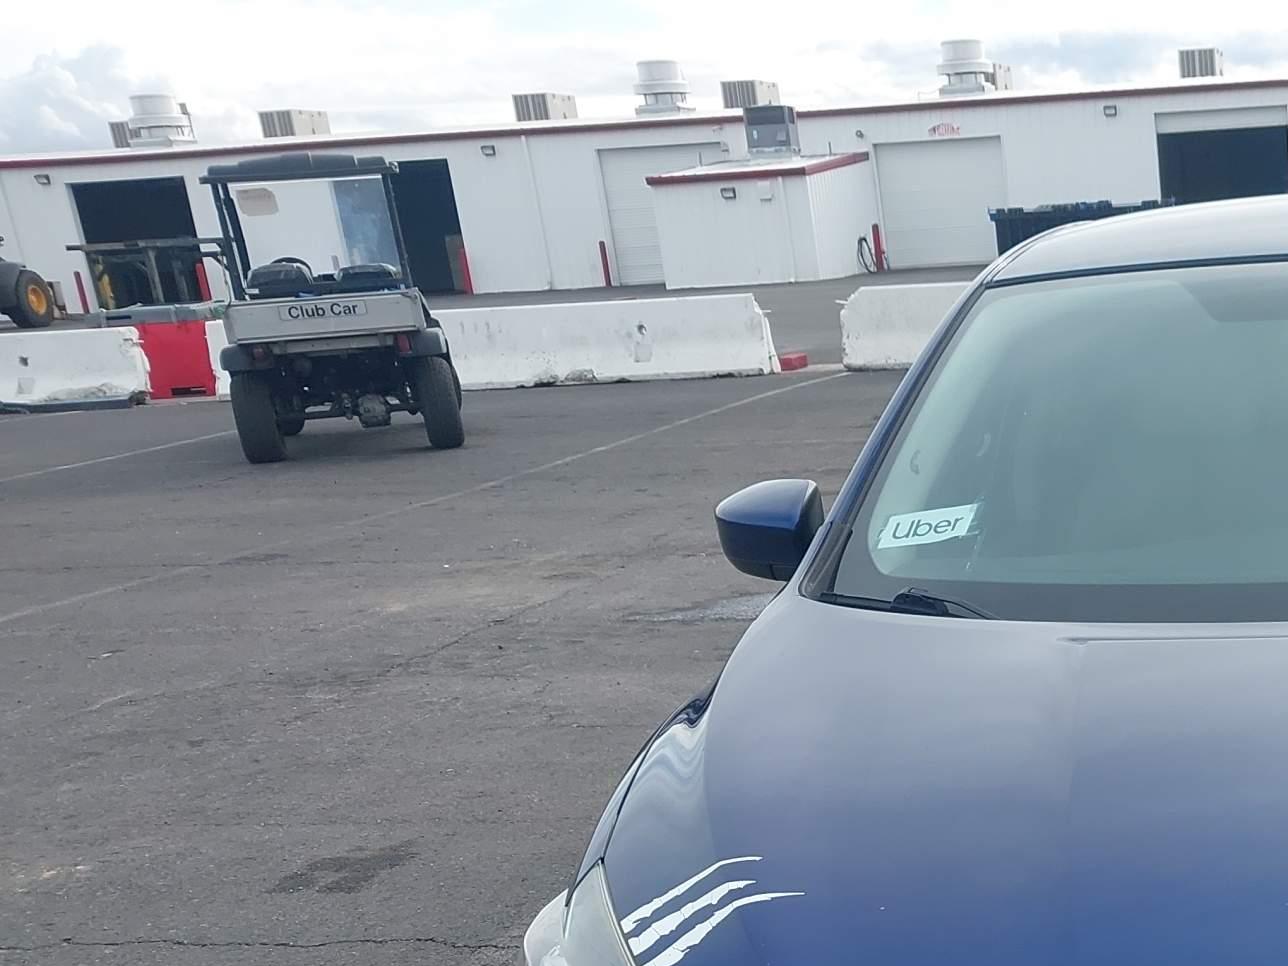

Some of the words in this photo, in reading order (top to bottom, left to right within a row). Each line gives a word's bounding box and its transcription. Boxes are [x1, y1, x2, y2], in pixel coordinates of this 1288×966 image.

[287, 304, 326, 319] Club
[330, 302, 358, 316] Car
[892, 516, 964, 540] Uber
